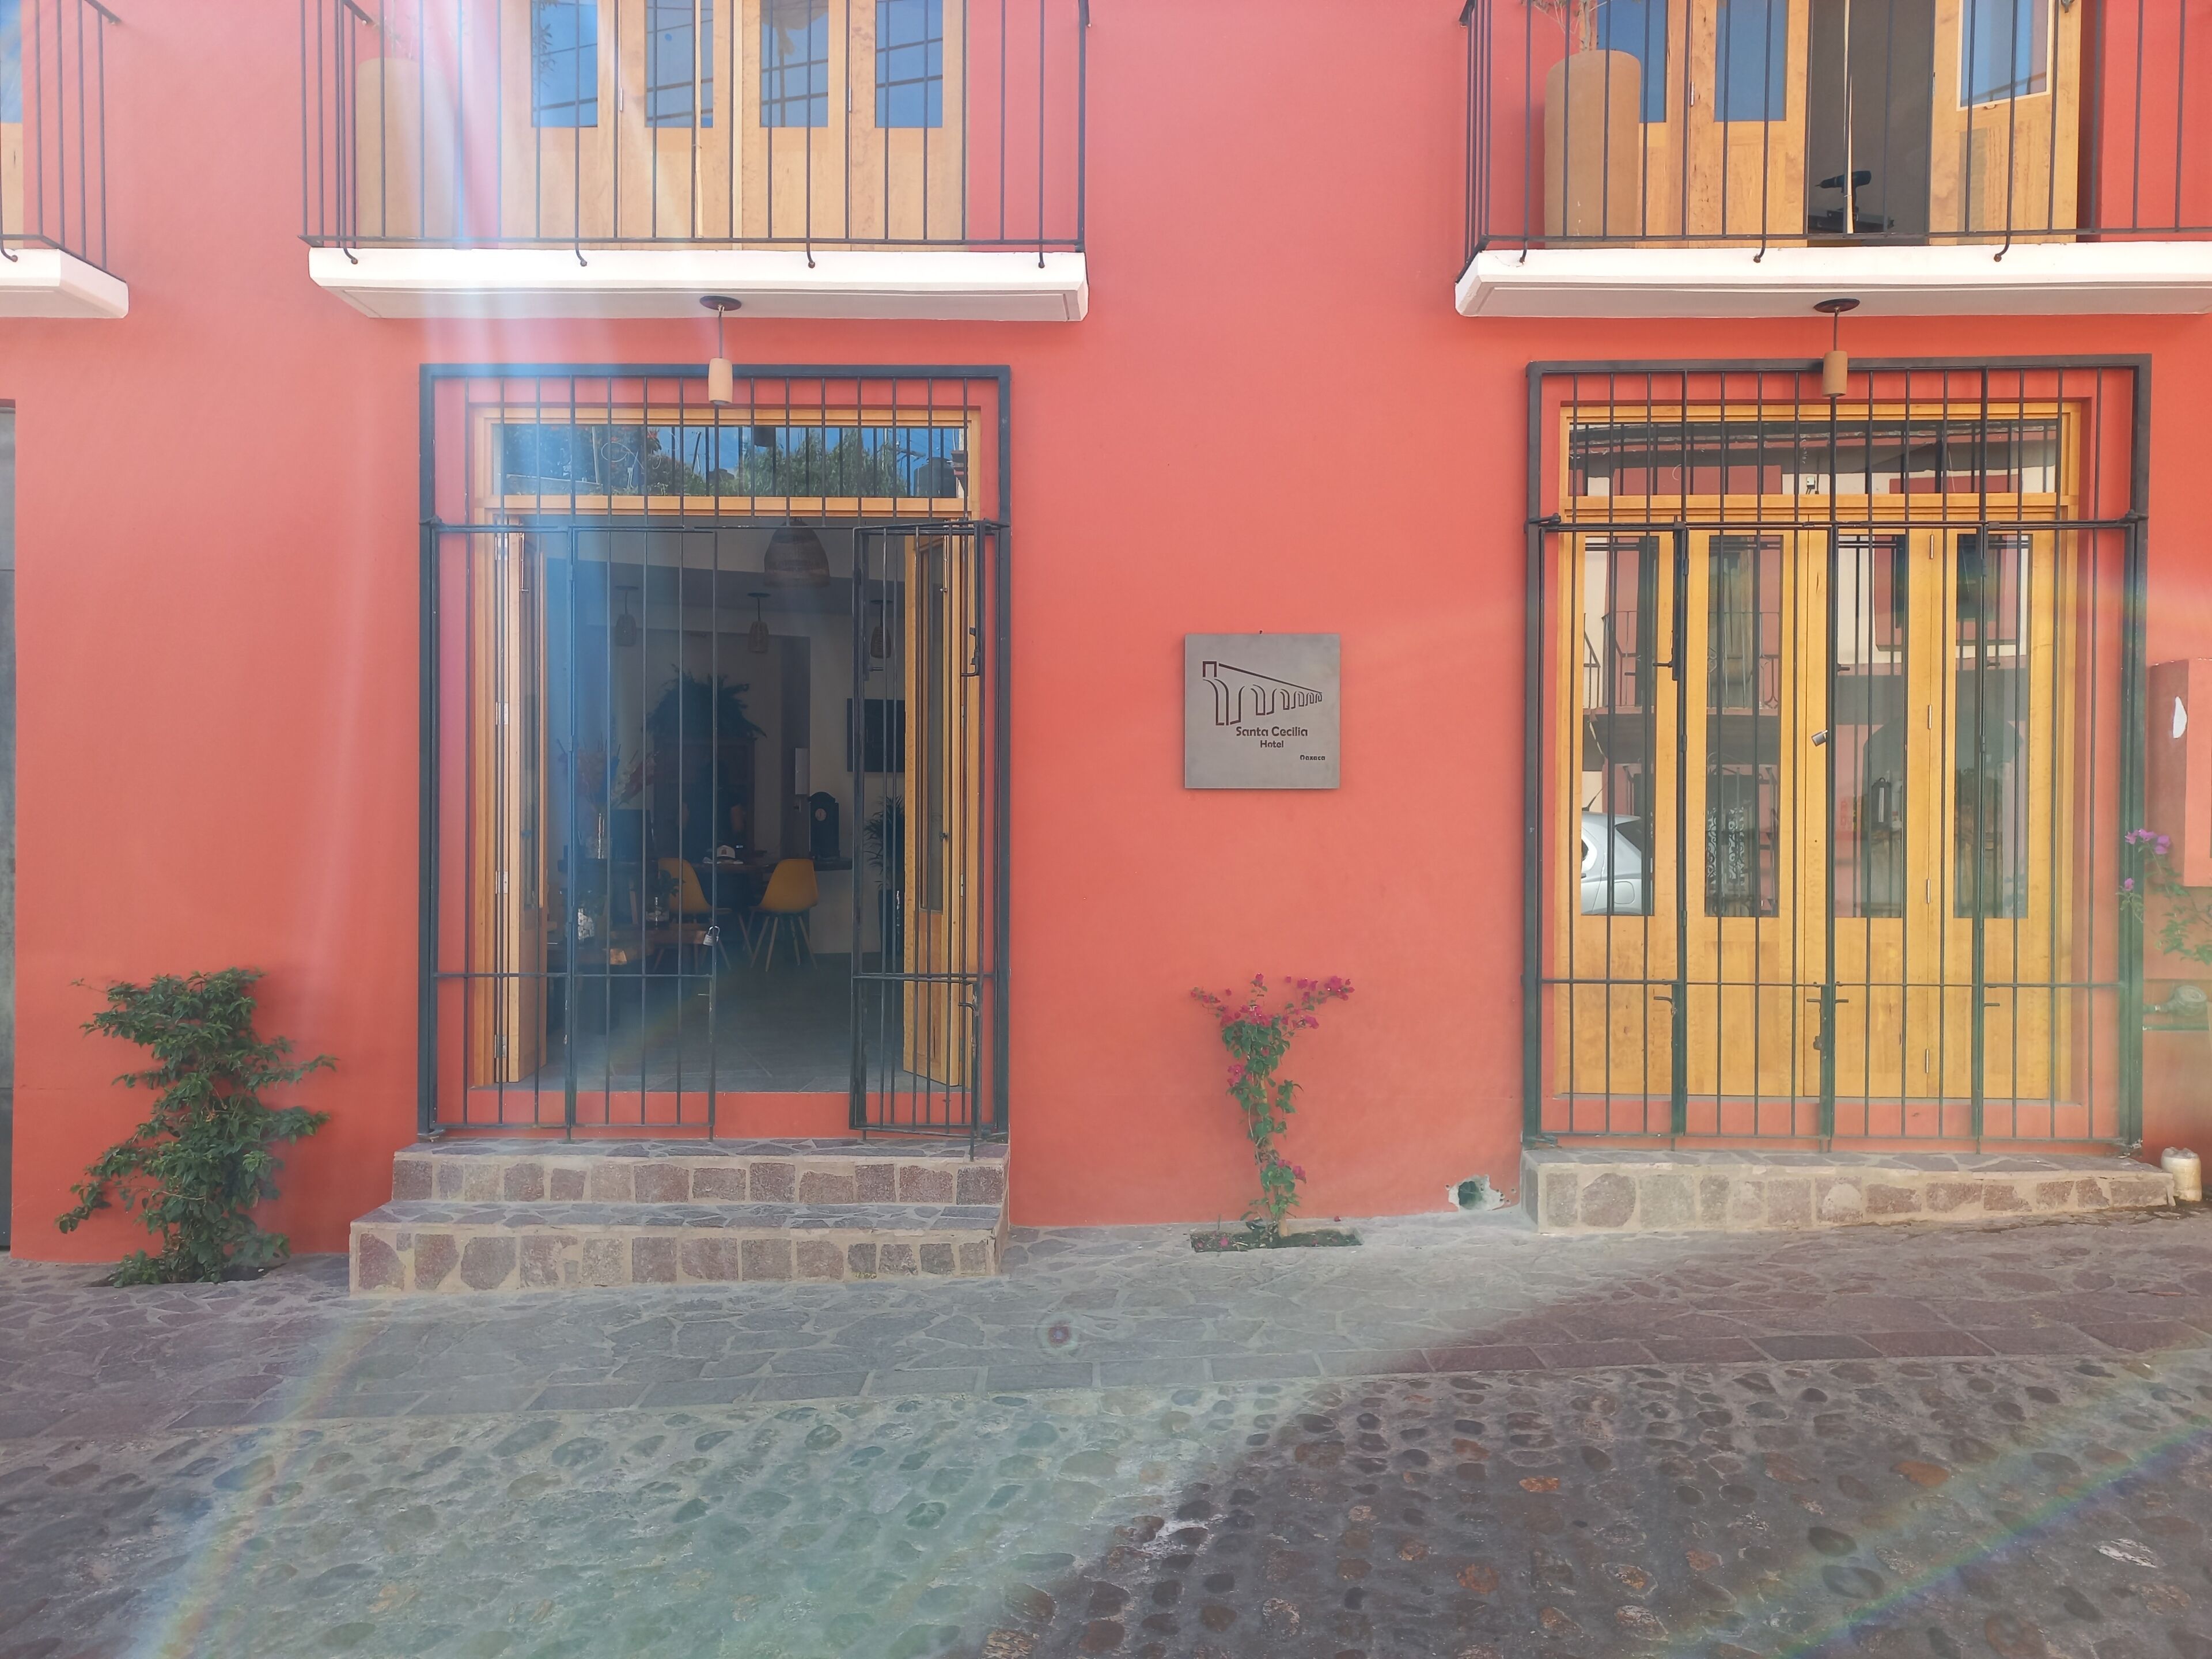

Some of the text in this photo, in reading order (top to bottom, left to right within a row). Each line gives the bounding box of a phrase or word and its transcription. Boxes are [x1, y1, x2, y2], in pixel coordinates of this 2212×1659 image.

[1236, 726, 1308, 736] Santa Cecilia
[1260, 740, 1284, 748] Hotel
